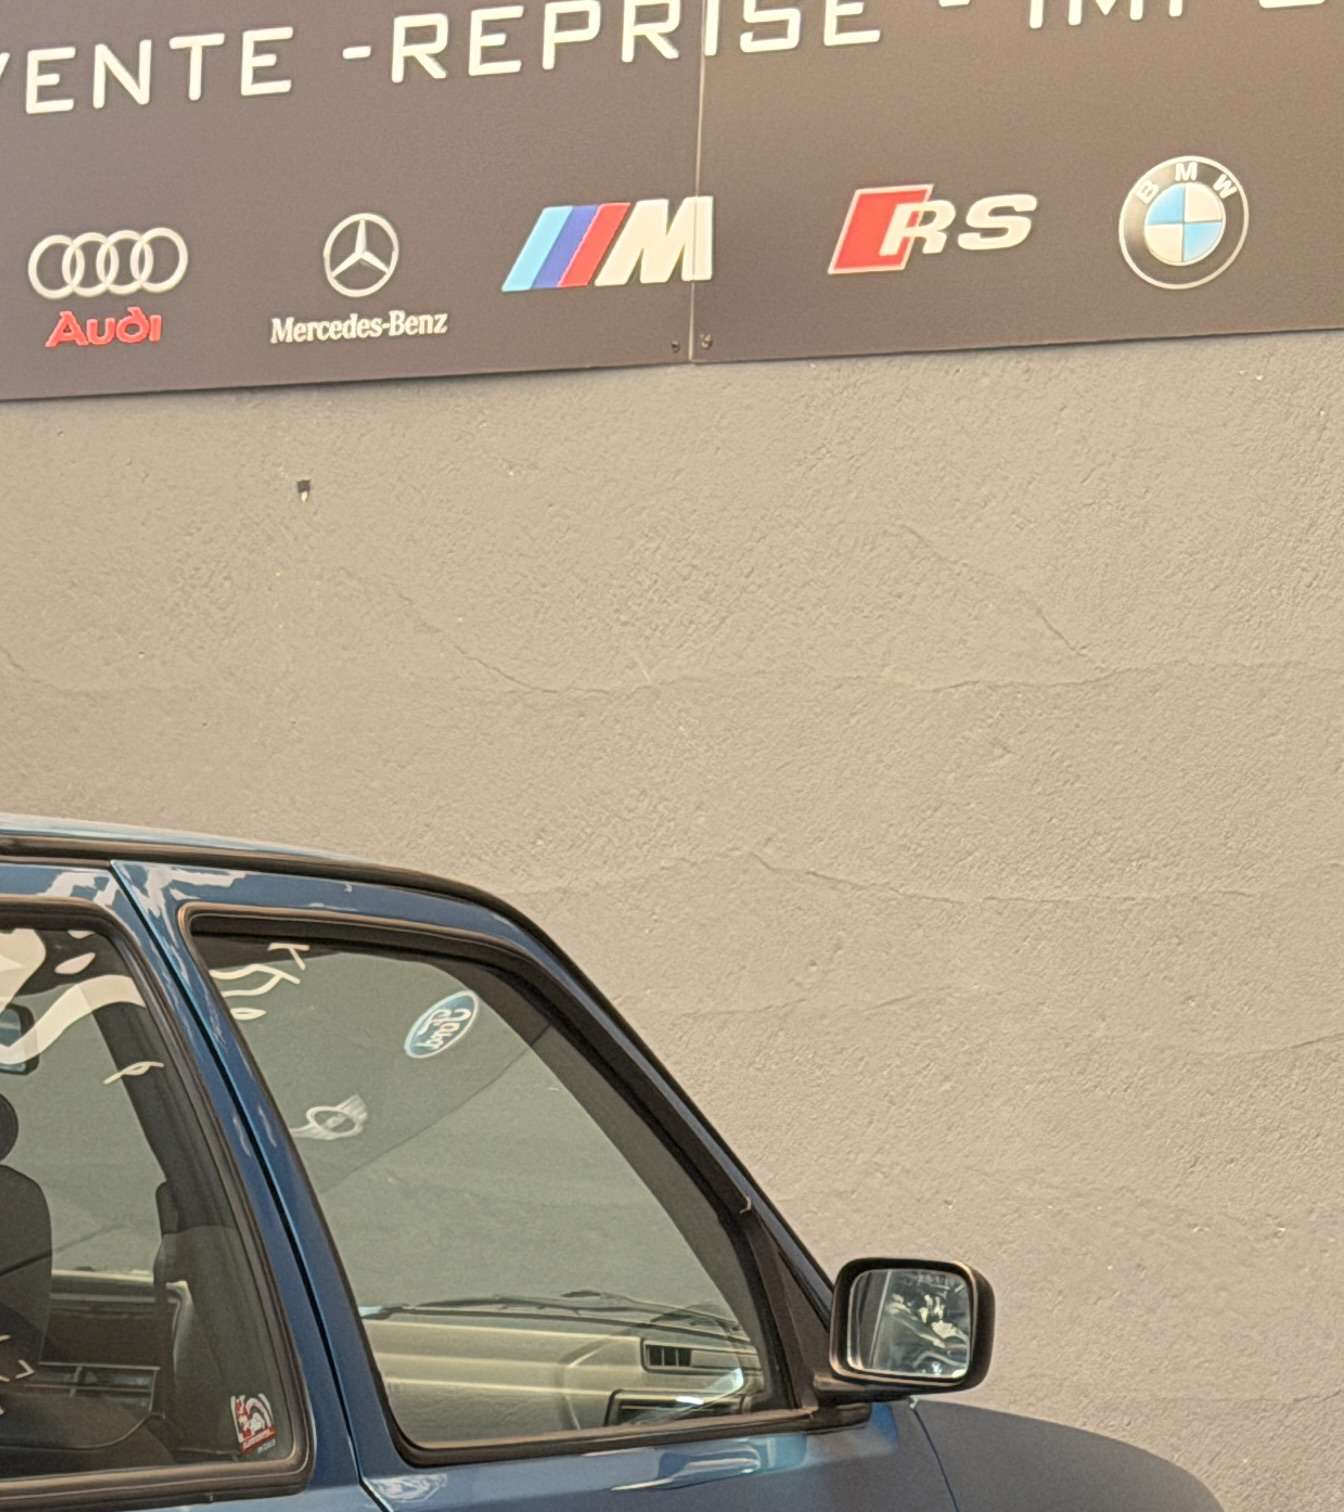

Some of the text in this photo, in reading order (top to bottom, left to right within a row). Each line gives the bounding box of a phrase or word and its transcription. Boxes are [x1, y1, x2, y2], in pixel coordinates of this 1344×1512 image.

[1134, 161, 1238, 207] BMW
[879, 194, 1038, 257] RS
[45, 306, 163, 348] Audi
[271, 309, 448, 344] Mercedes-Benz
